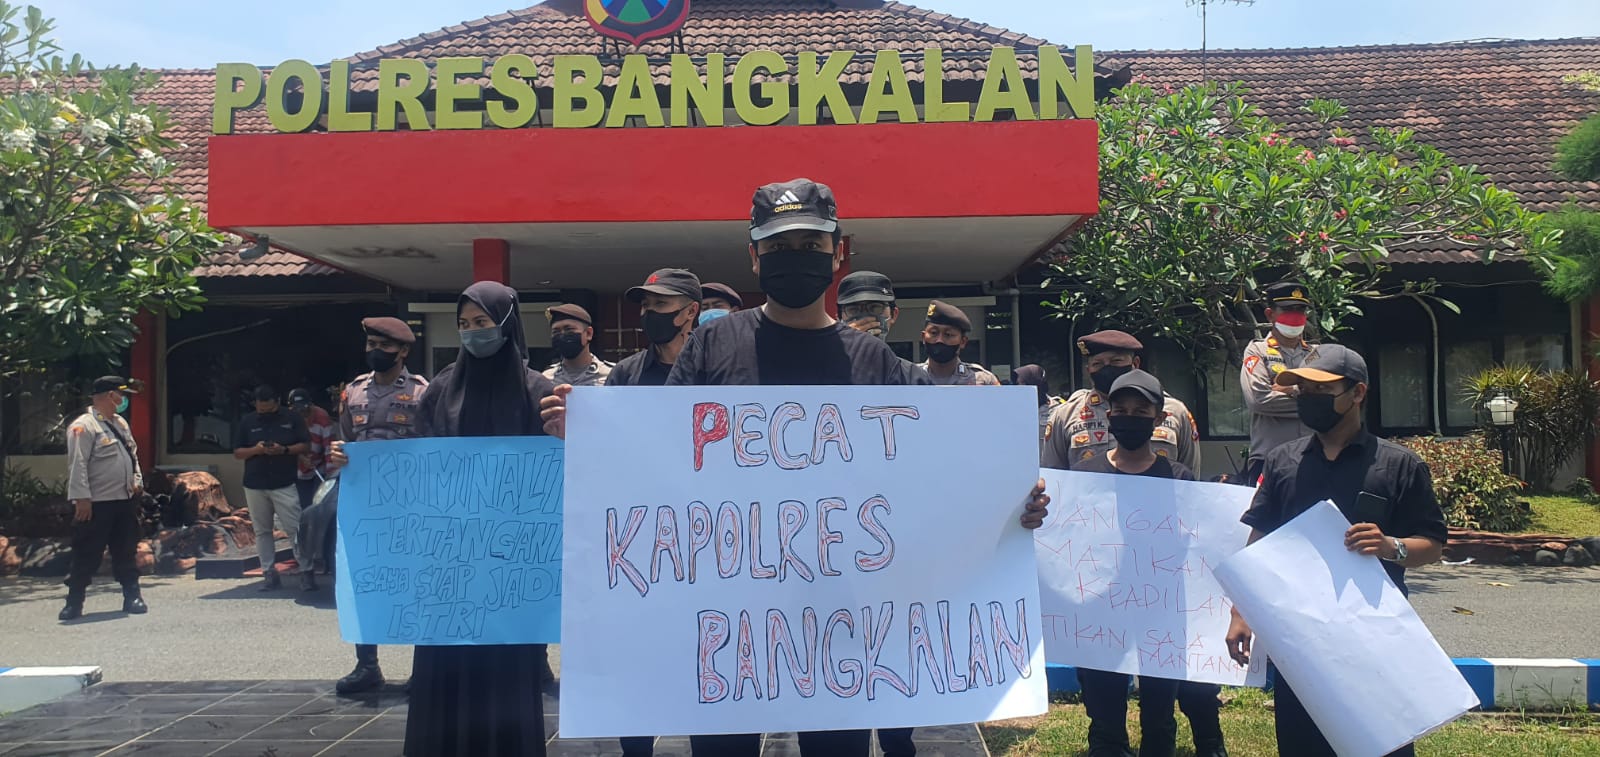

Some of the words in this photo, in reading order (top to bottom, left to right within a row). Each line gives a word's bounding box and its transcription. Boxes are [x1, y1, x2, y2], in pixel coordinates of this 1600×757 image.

[212, 54, 538, 135] POLRES
[553, 44, 1095, 129] BANGKALAN
[774, 203, 802, 213] adidas
[692, 402, 919, 471] PECAT
[1037, 480, 1199, 542] JANGAN
[606, 494, 895, 597] KAPOLRES
[353, 565, 410, 594] SAYA
[414, 563, 476, 601] SIAP
[387, 600, 487, 641] ISTRI
[697, 598, 1031, 703] BANGKALAN
[1143, 625, 1205, 651] SAJA
